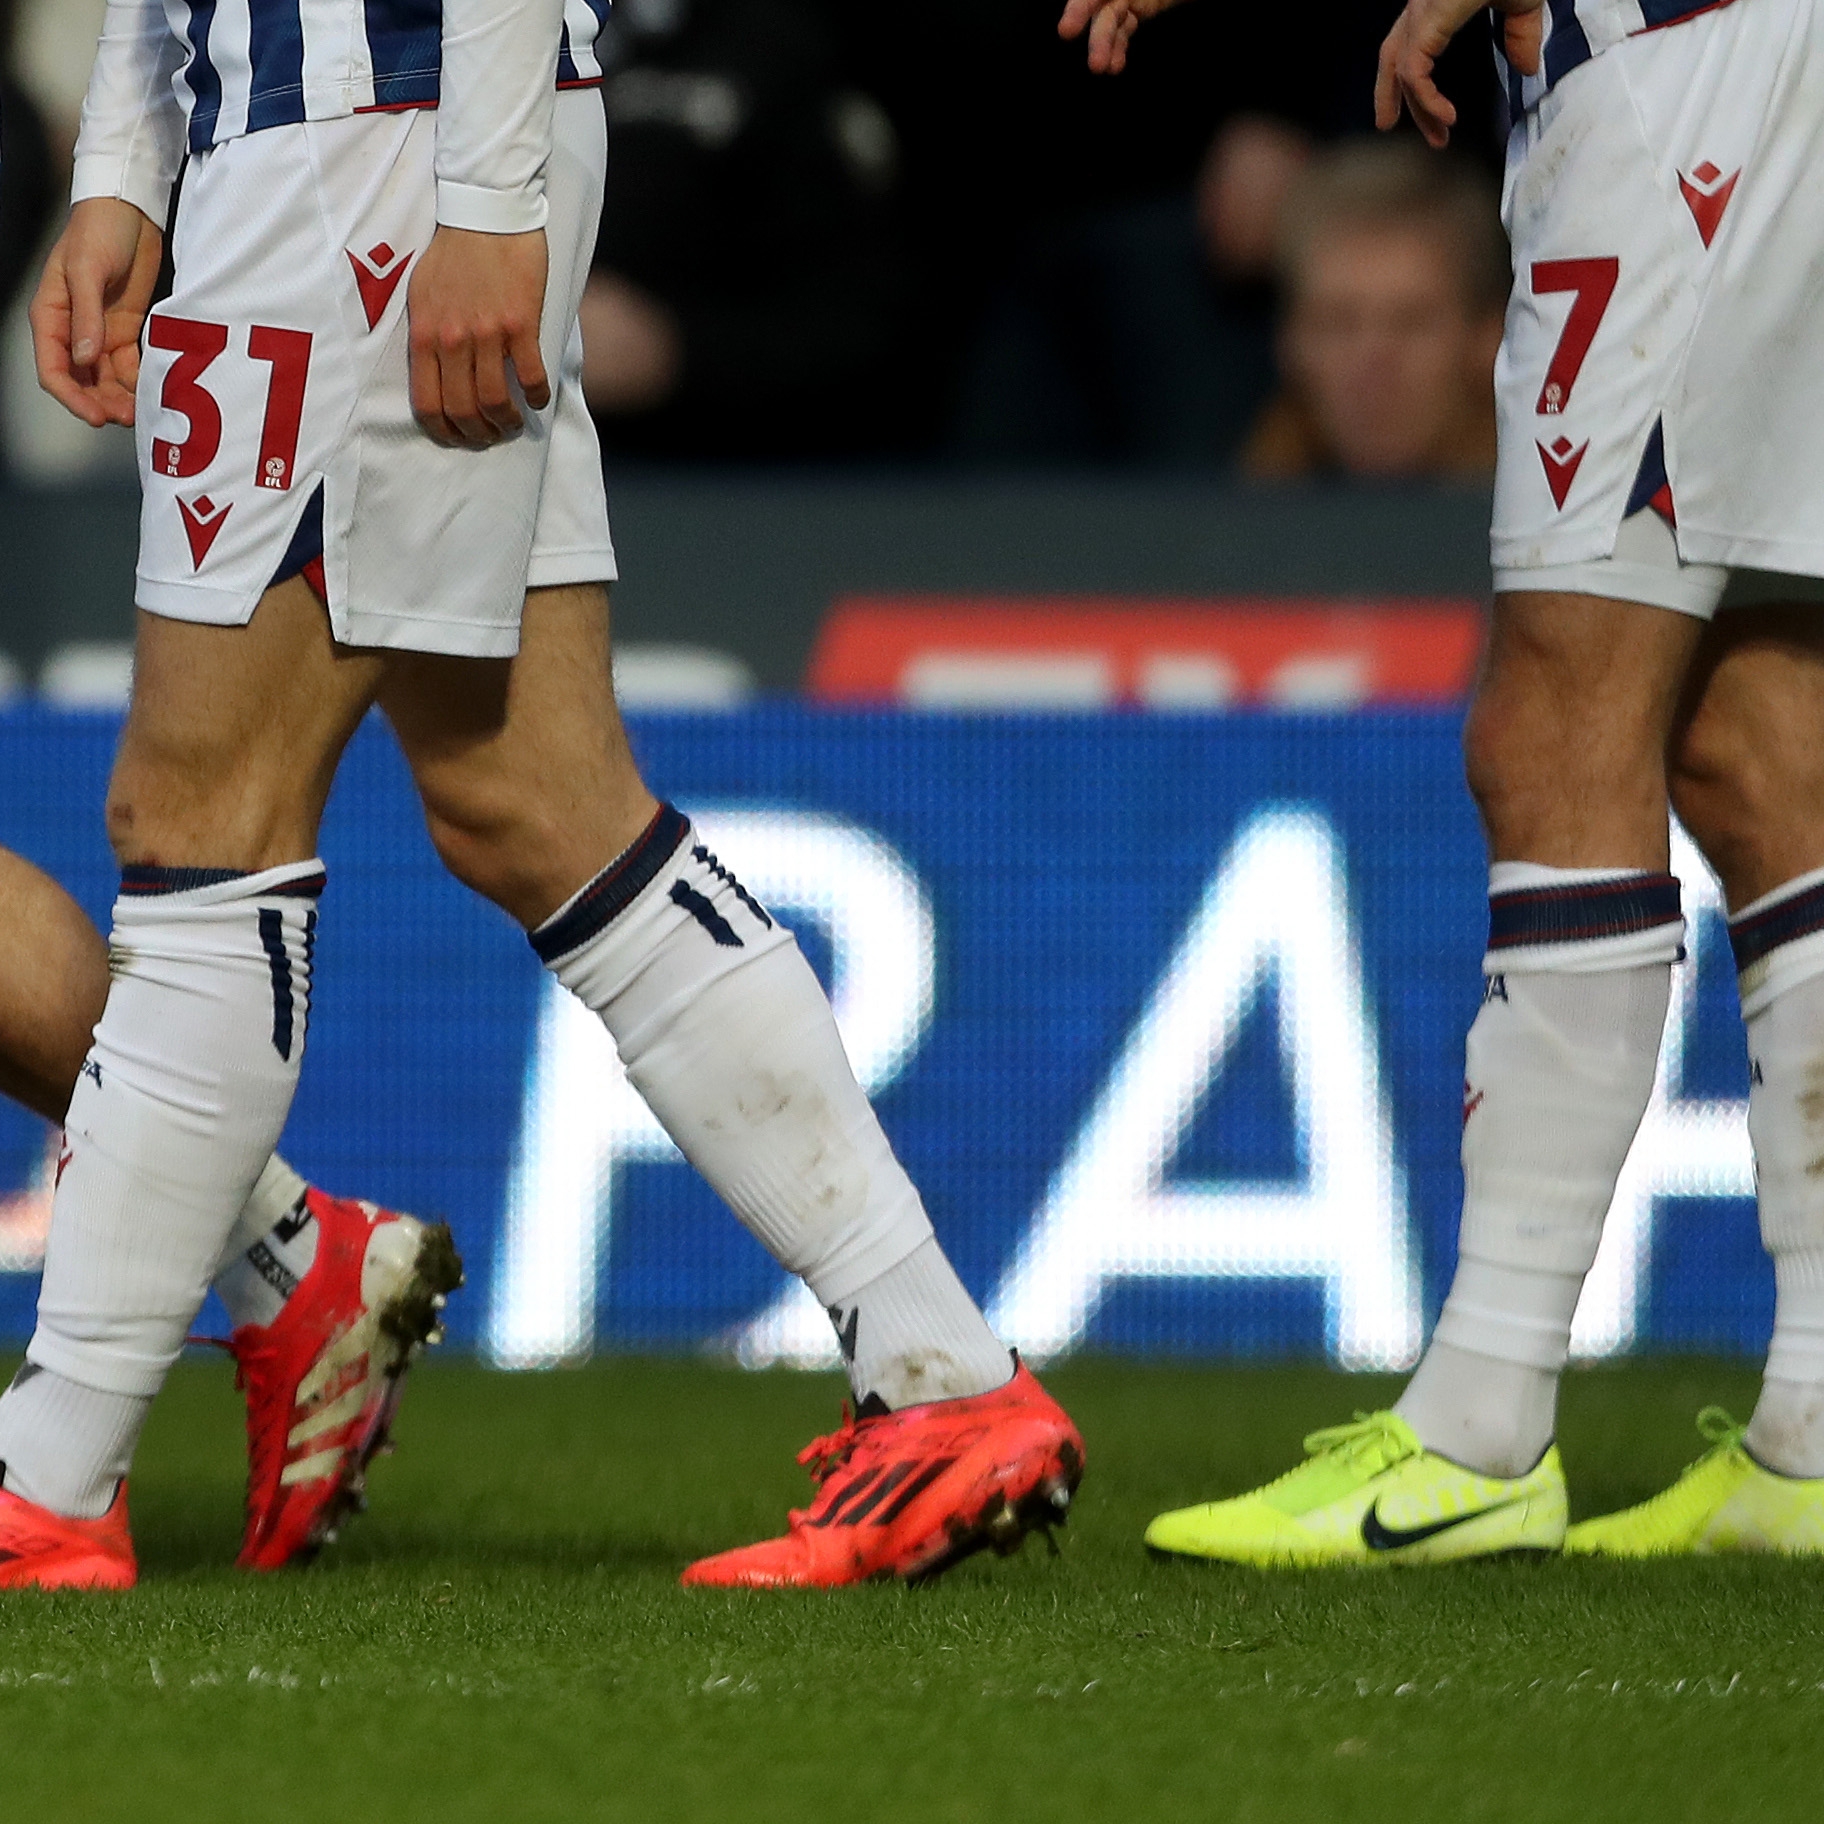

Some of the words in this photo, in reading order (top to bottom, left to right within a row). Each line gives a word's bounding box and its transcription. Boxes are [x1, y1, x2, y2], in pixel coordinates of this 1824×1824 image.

[149, 314, 314, 491] 31
[1531, 256, 1619, 414] 7
[264, 476, 282, 488] EFL
